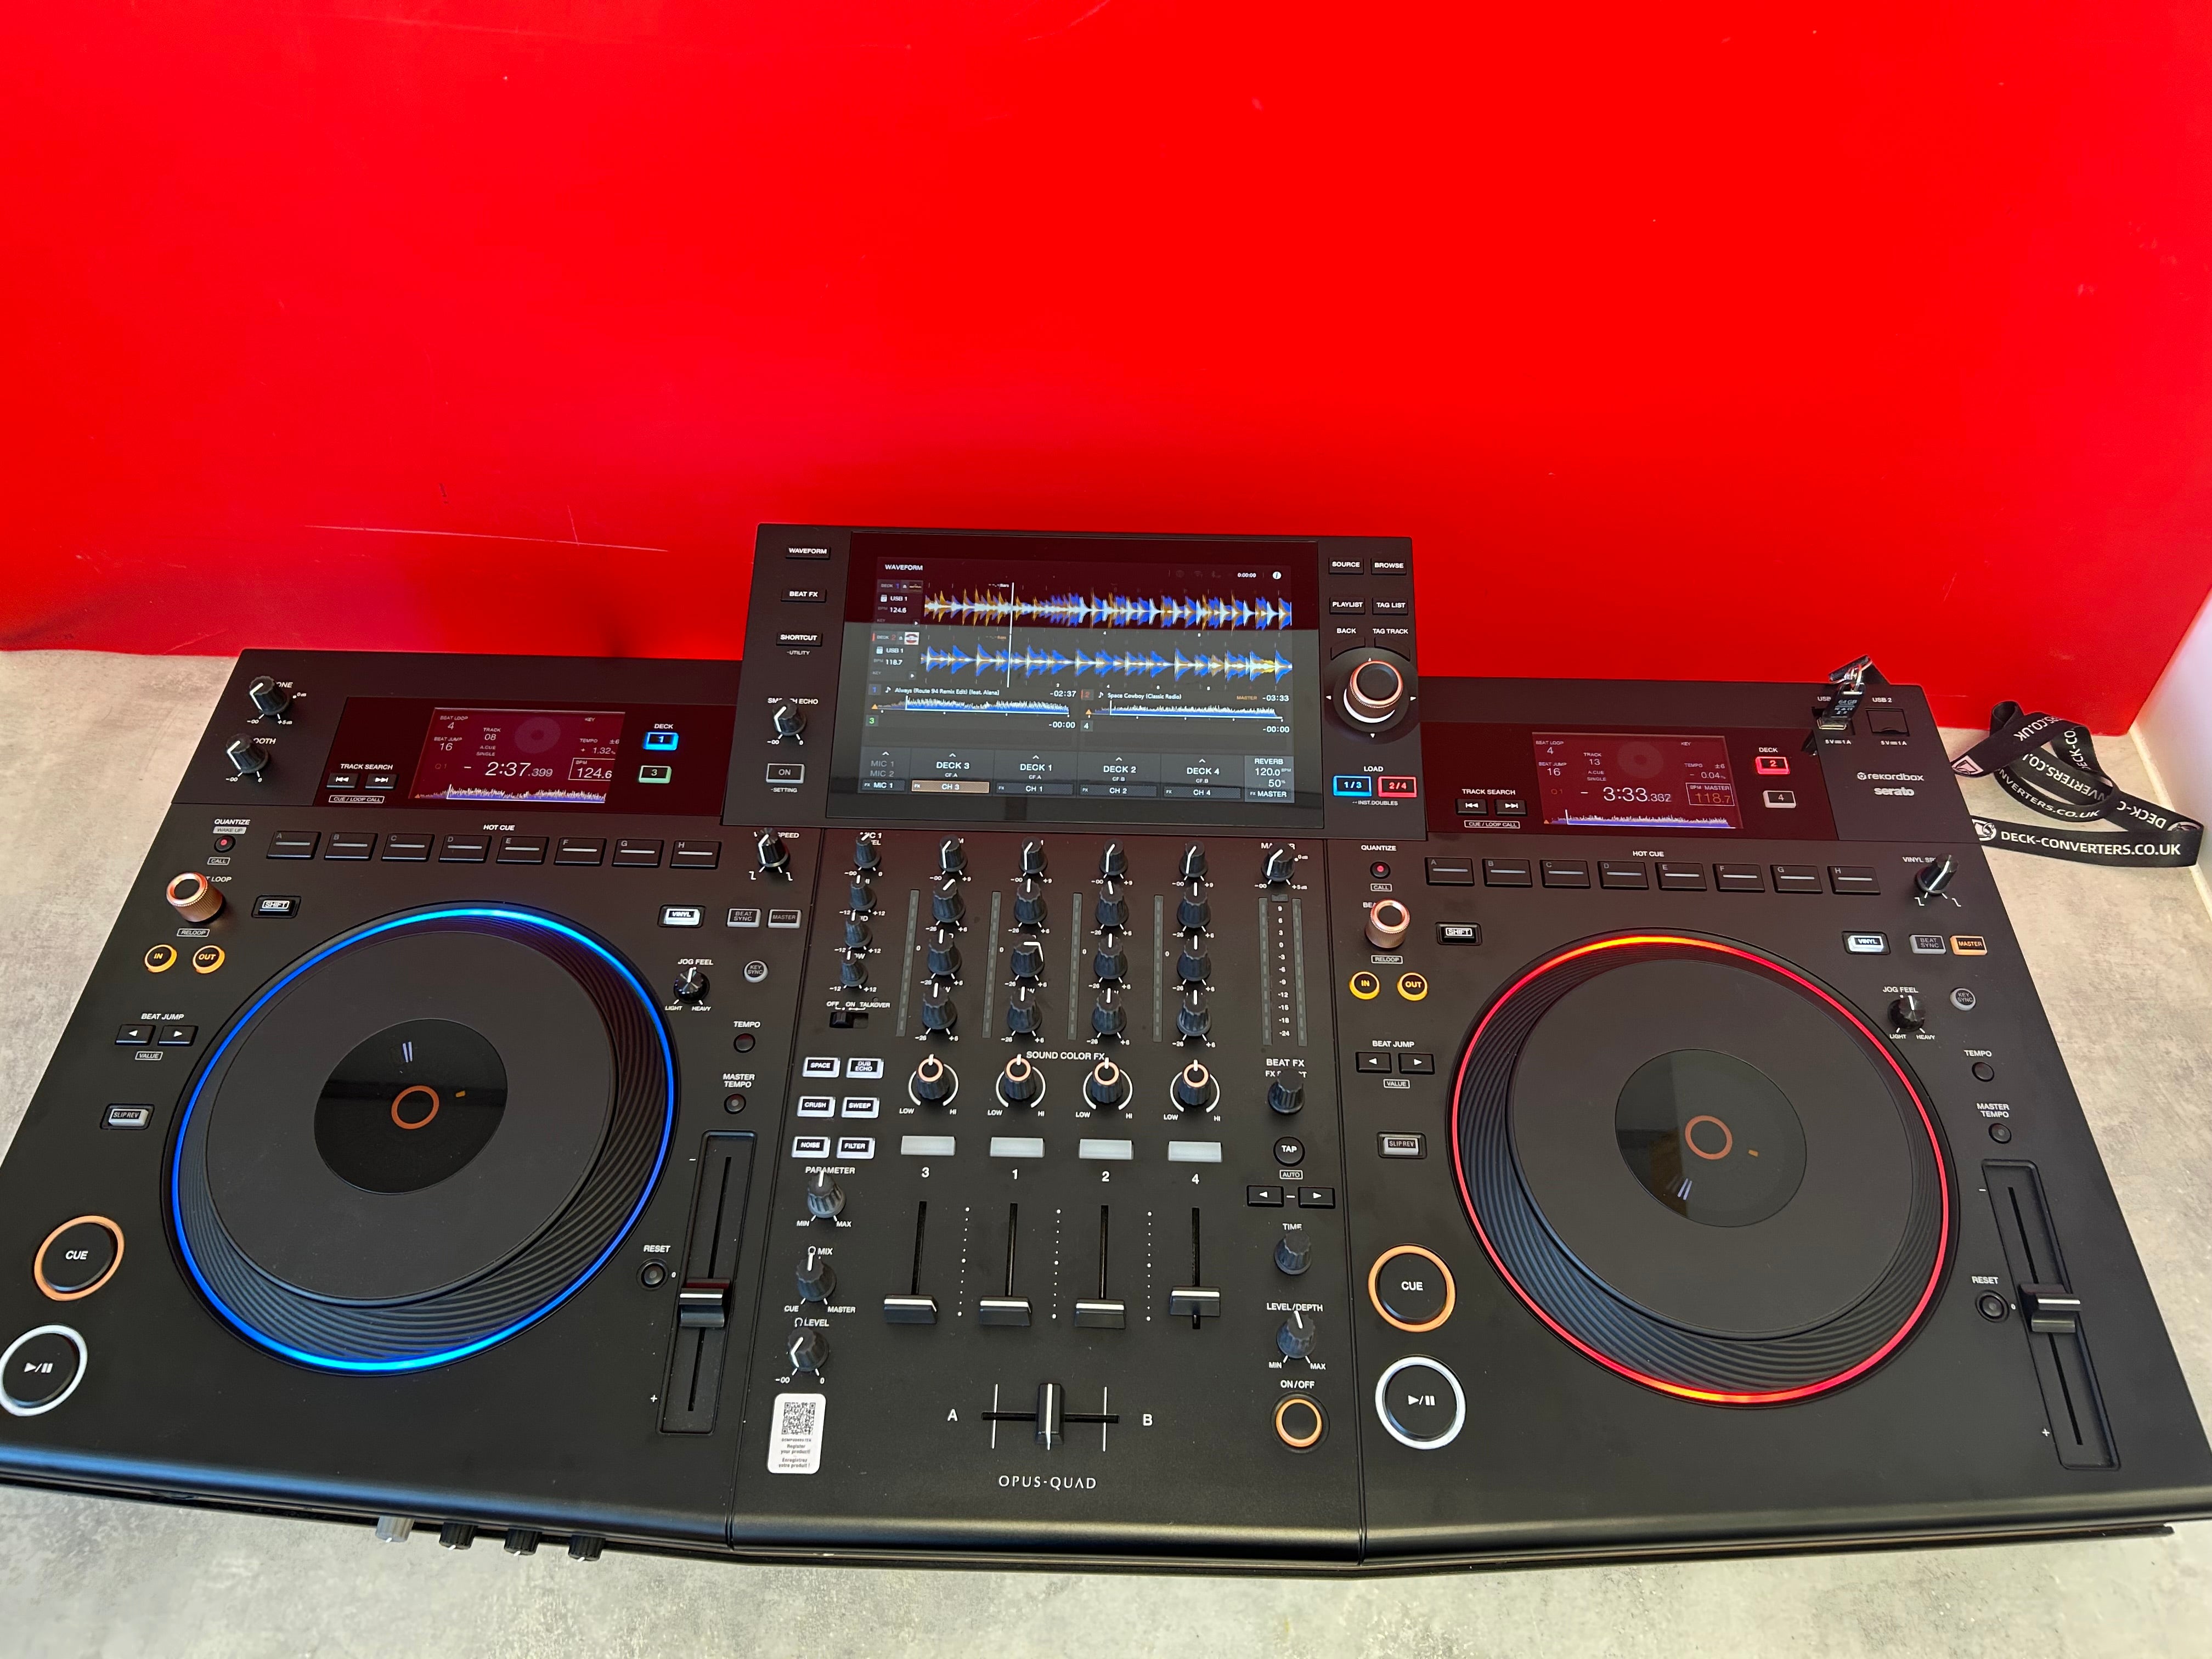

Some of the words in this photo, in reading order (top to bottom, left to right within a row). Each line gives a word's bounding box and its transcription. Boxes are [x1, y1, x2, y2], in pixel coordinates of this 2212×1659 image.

[440, 743, 453, 751] 16
[577, 768, 612, 778] 124.6
[1255, 768, 1281, 776] 120.0
[1547, 768, 1561, 776] 16
[1867, 772, 1924, 781] rekordbox
[1874, 787, 1915, 797] serato
[1695, 793, 1731, 804] 118.7
[2001, 831, 2181, 856] DECK-CONVERTERS.CO.UK
[1026, 1051, 1059, 1059] SOUND
[1060, 1051, 1091, 1060] COLOR
[1094, 1052, 1105, 1060] FX
[1266, 1058, 1290, 1066] BEAT
[1293, 1059, 1305, 1067] FX
[922, 1167, 930, 1178] 3
[1102, 1171, 1110, 1182] 2
[1192, 1173, 1200, 1184] 4
[644, 1245, 671, 1253] RESET
[65, 1250, 88, 1260] CUE
[1972, 1276, 1999, 1284] RESET
[1401, 1281, 1424, 1291] CUE
[1266, 1302, 1323, 1312] LEVEL/DEPTH
[804, 1318, 830, 1327] LEVEL
[1280, 1380, 1315, 1389] ON/OFF
[947, 1408, 958, 1421] A
[1143, 1413, 1153, 1426] B
